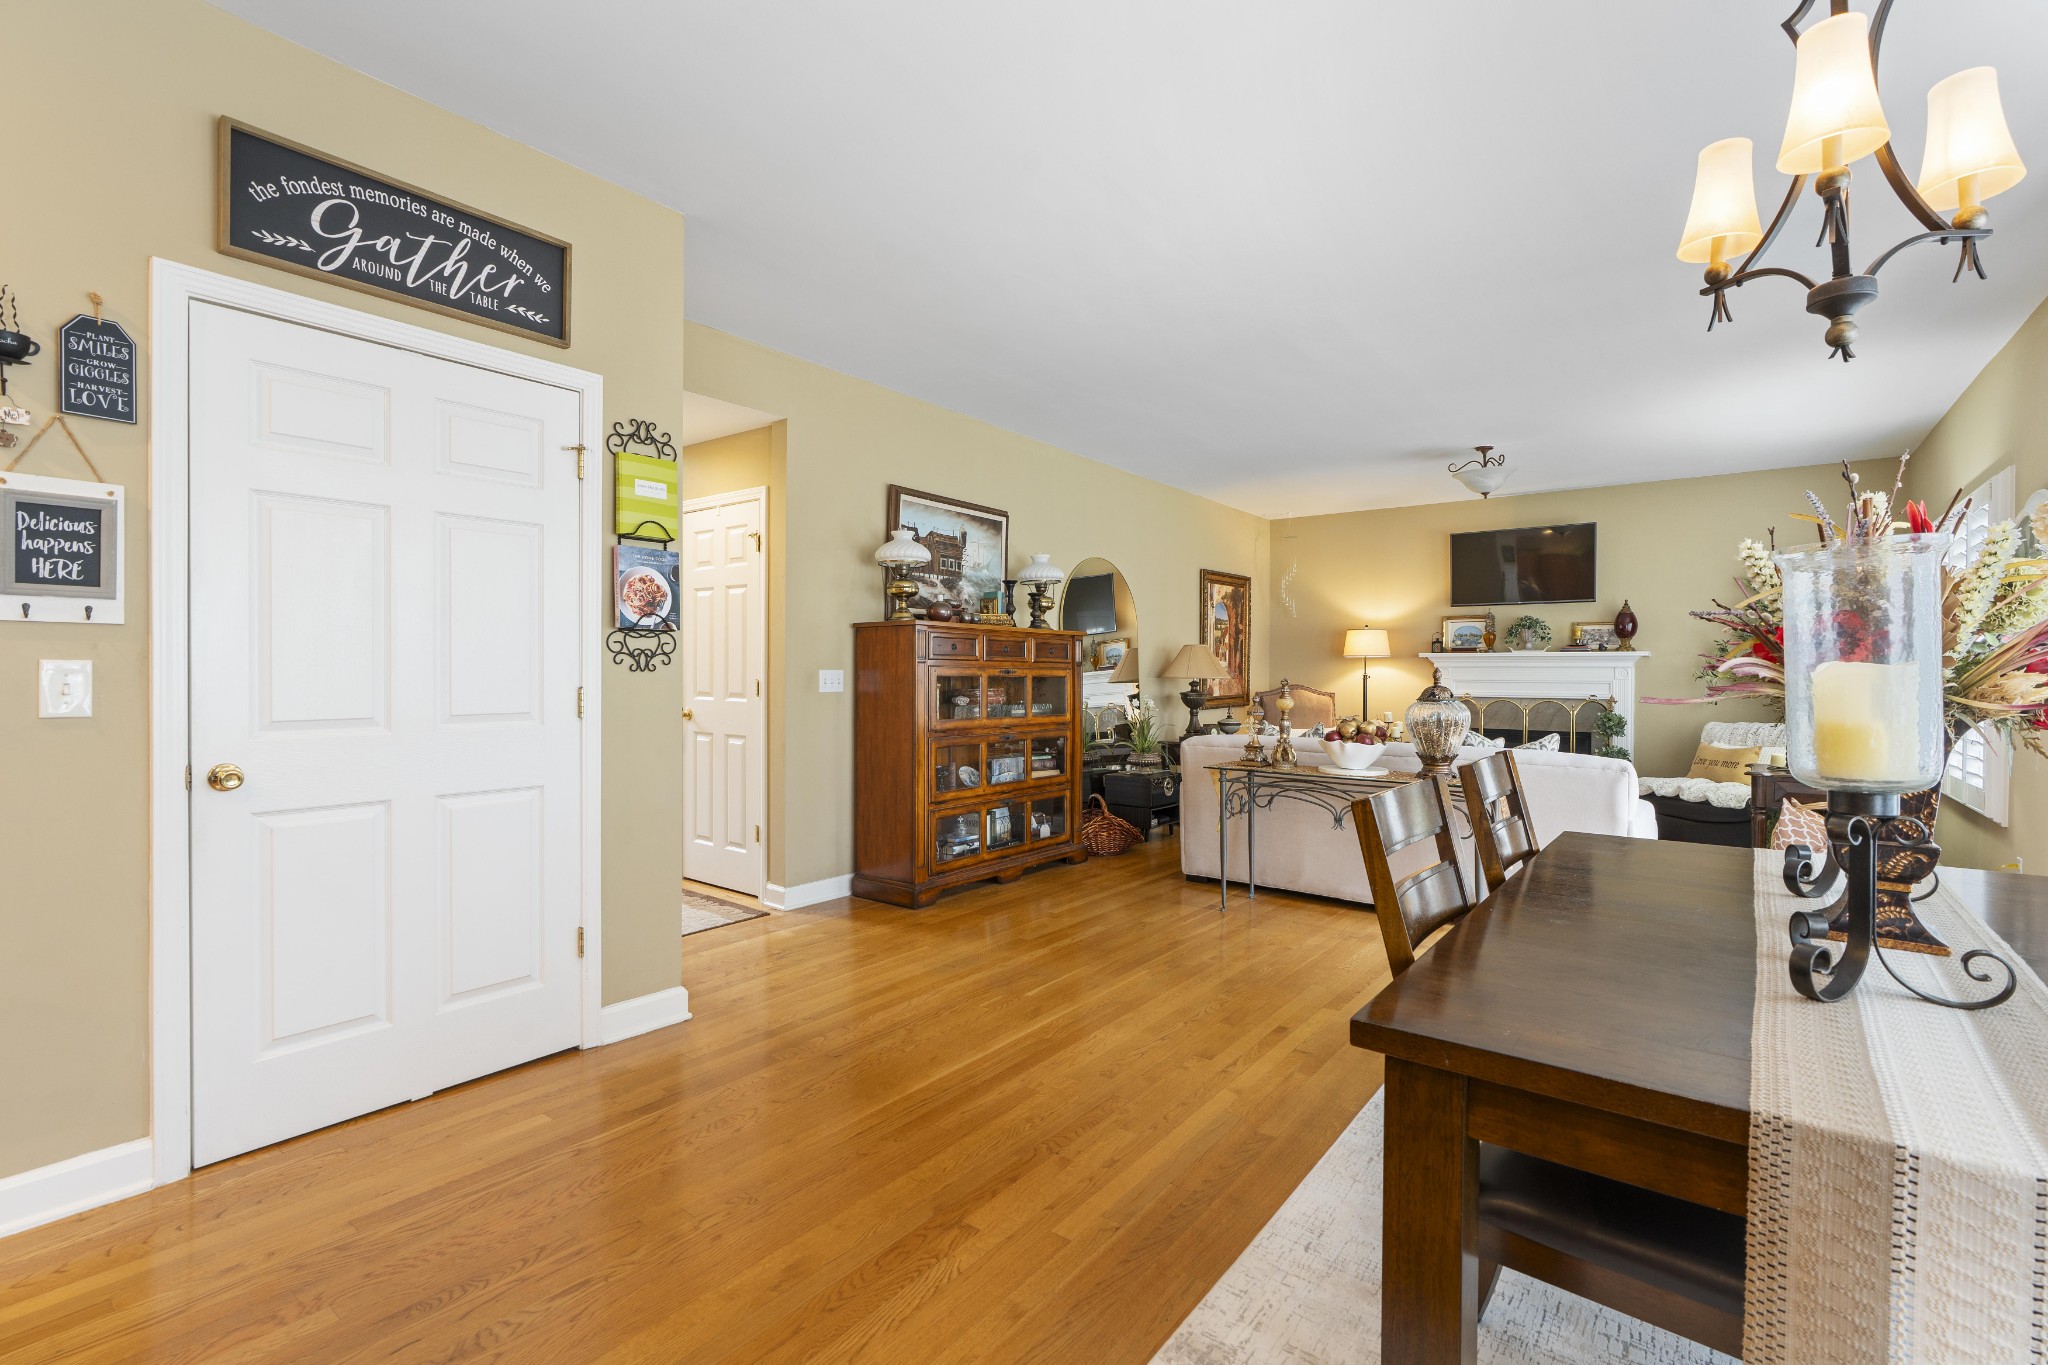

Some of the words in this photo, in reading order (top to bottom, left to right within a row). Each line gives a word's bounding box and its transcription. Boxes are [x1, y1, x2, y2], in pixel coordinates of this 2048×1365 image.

[248, 181, 280, 203] the
[280, 176, 346, 198] fondest
[349, 184, 427, 218] memories
[431, 207, 455, 229] are
[458, 219, 497, 250] made
[499, 244, 533, 278] when
[533, 272, 552, 294] we
[352, 256, 402, 283] AROUND
[428, 278, 448, 297] THE
[469, 291, 499, 311] TABLE
[68, 336, 130, 361] SMILES
[86, 331, 116, 343] PLANT
[68, 362, 130, 385] GIGGLES
[86, 358, 117, 369] GROW
[69, 387, 130, 413] LOVE
[77, 381, 123, 396] HARVEST
[16, 510, 98, 535] Delicious
[21, 530, 96, 555] happens
[31, 557, 84, 581] HERE
[1694, 756, 1707, 765] Love
[1705, 759, 1720, 769] you
[1721, 760, 1739, 769] more
